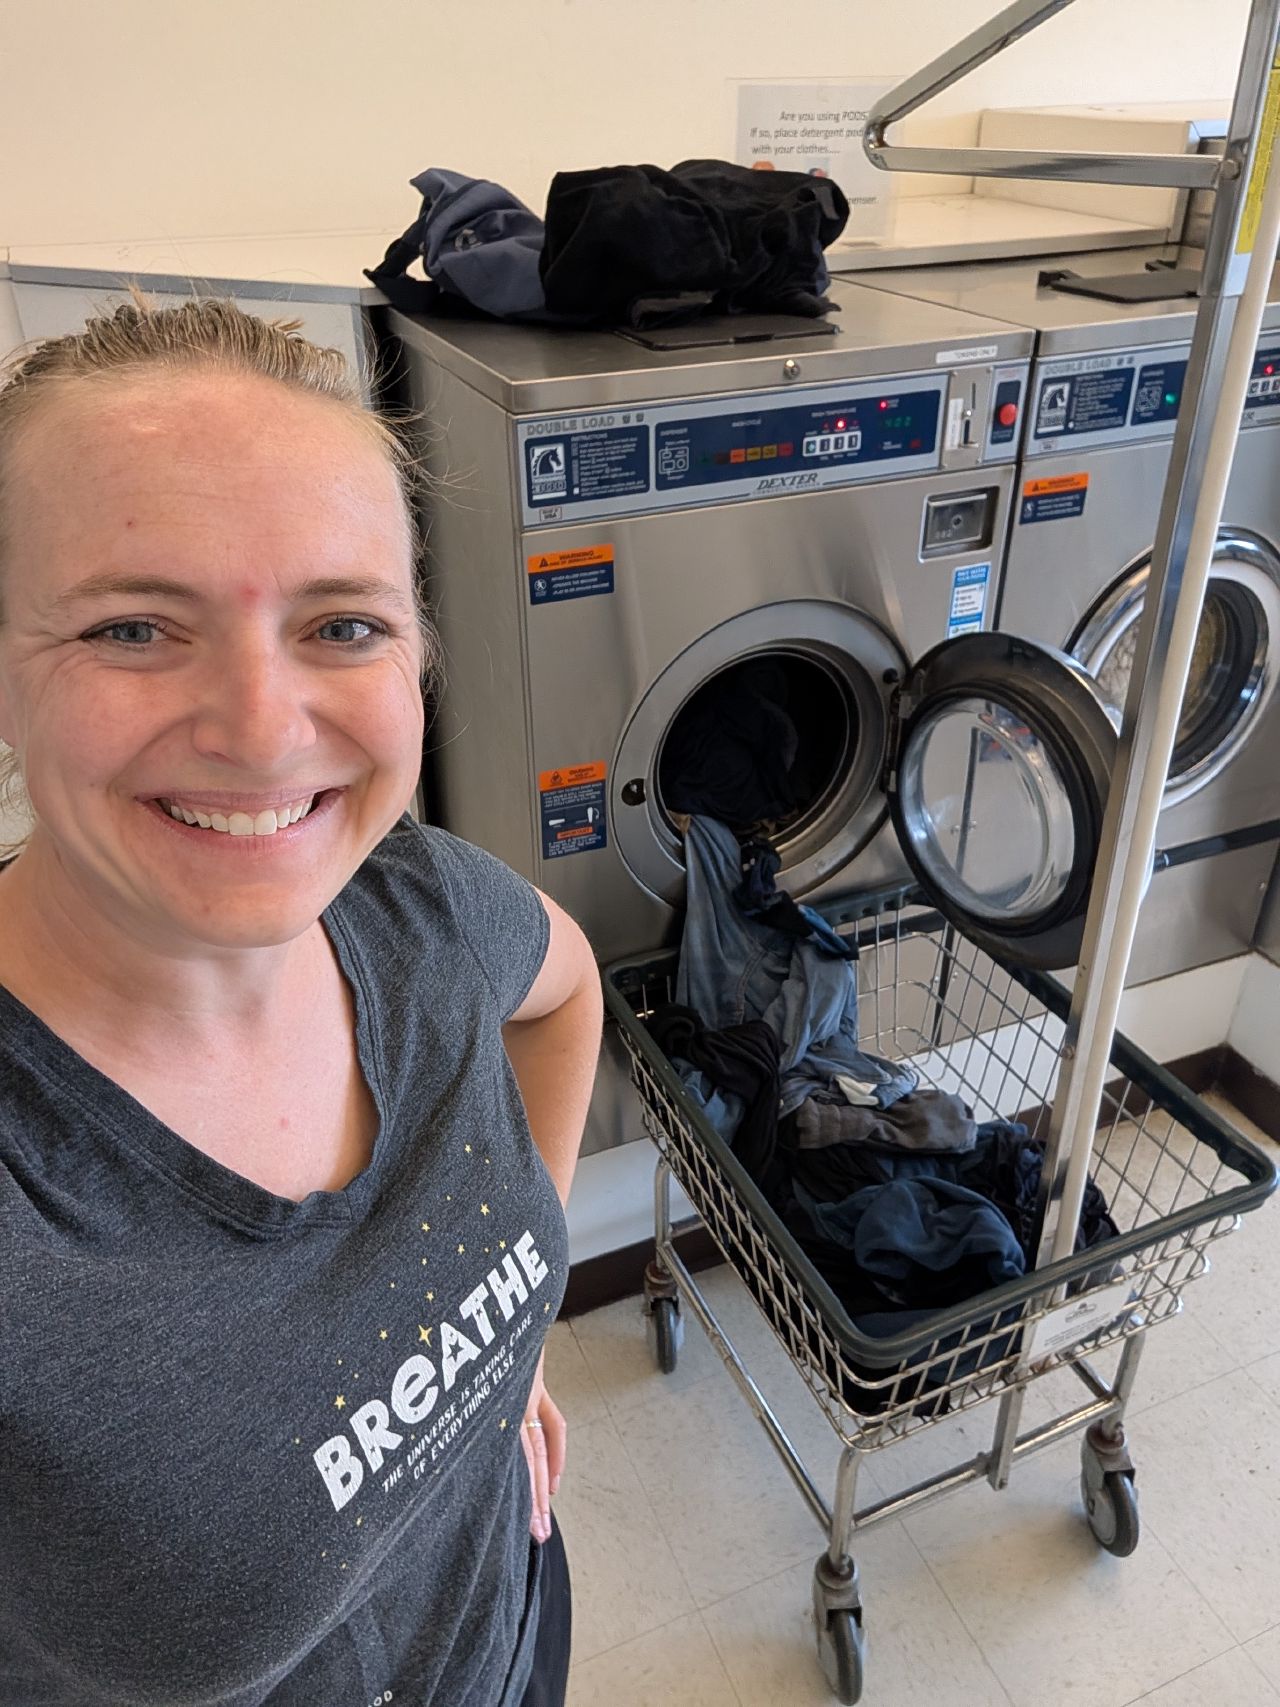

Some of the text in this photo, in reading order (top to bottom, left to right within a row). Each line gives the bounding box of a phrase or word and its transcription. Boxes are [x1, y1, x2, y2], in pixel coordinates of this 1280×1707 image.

[779, 111, 869, 123] Are you using PODS
[774, 128, 797, 139] place
[799, 127, 843, 139] detergent
[845, 127, 865, 138] pod
[751, 144, 771, 154] with
[773, 146, 794, 155] your
[526, 415, 615, 436] DOUBLE LOAD
[757, 472, 818, 490] DEXTER
[381, 1310, 534, 1493] THE UNIVERSE IS TAKING CARE
[413, 1350, 516, 1481] OF EVERYTHING ELSE
